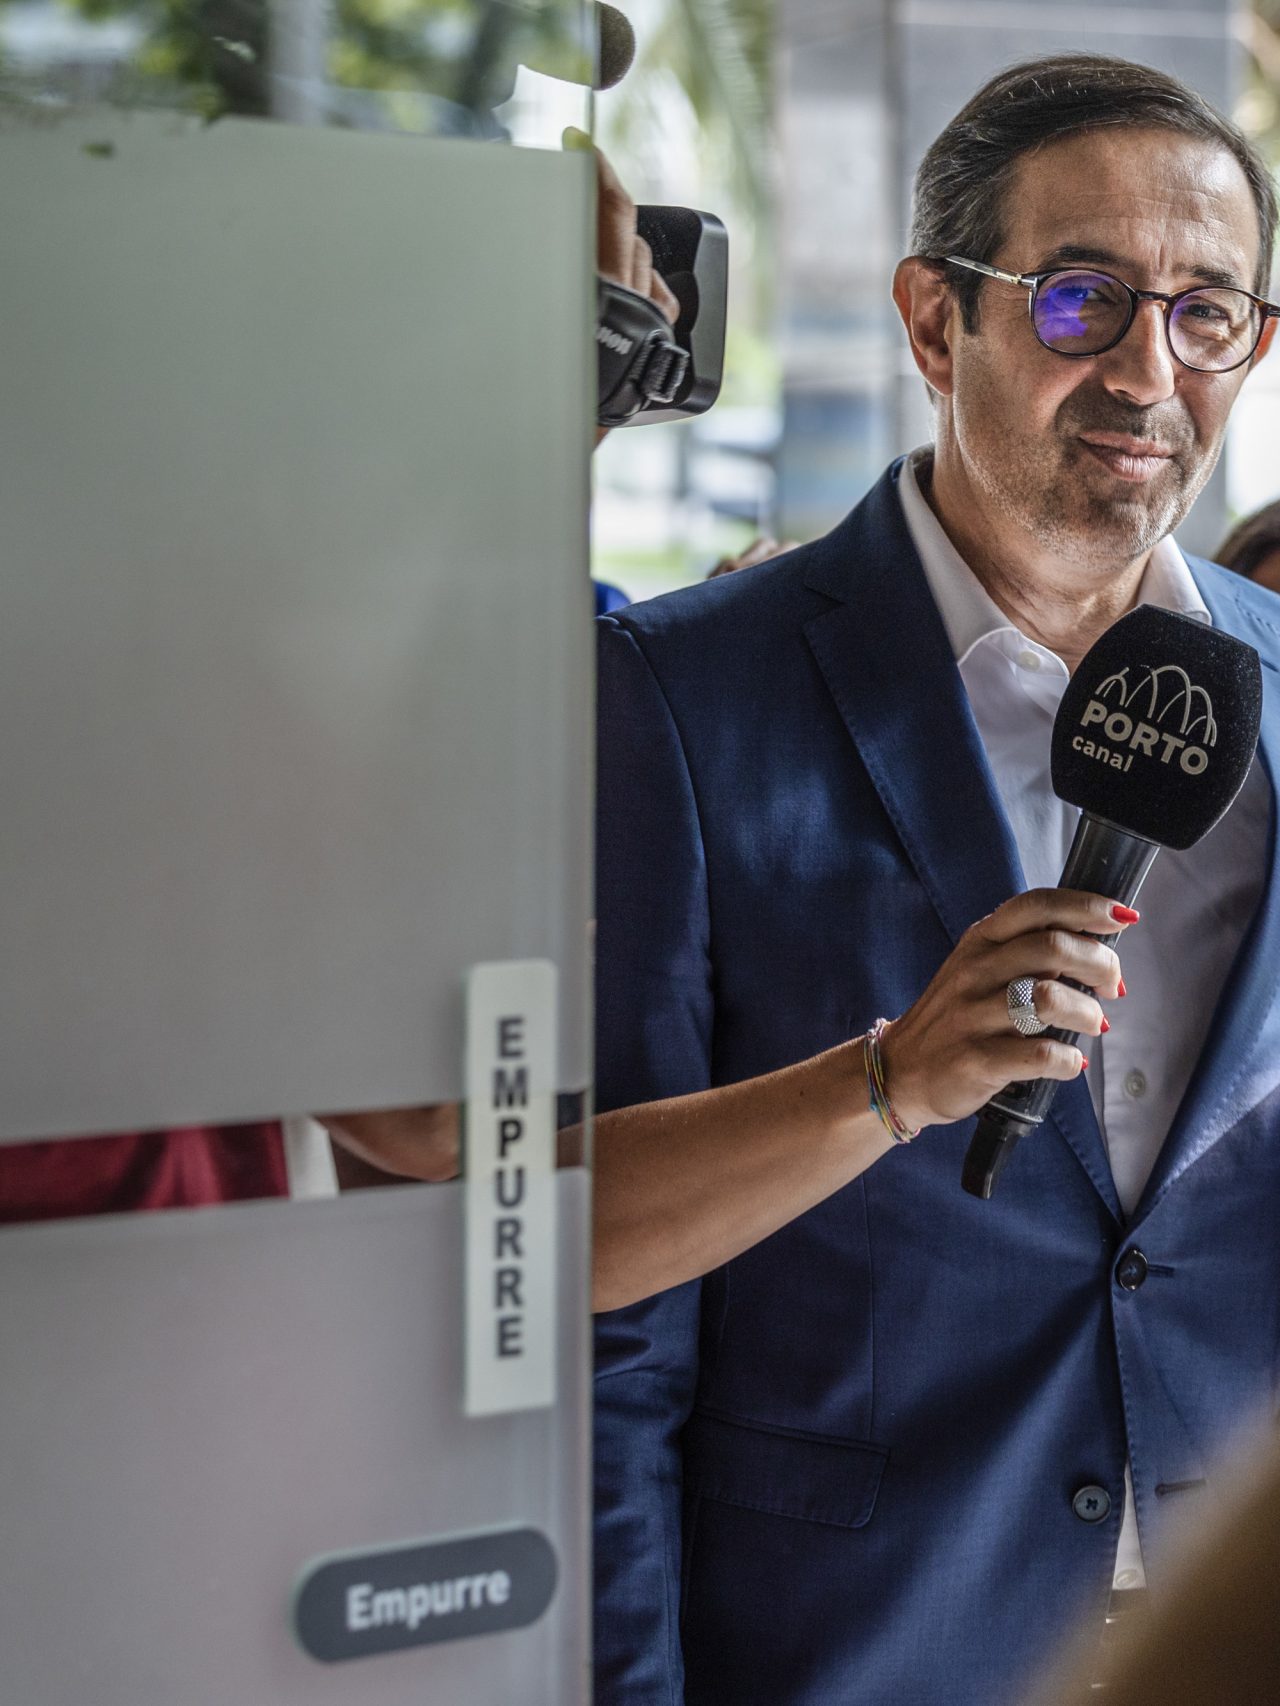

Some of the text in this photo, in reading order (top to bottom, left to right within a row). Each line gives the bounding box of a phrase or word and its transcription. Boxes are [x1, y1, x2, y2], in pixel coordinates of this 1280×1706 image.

[1072, 735, 1134, 772] canal
[1080, 700, 1209, 776] PORTO
[492, 1016, 528, 1358] EMPURRE
[346, 1570, 511, 1631] Empurre
